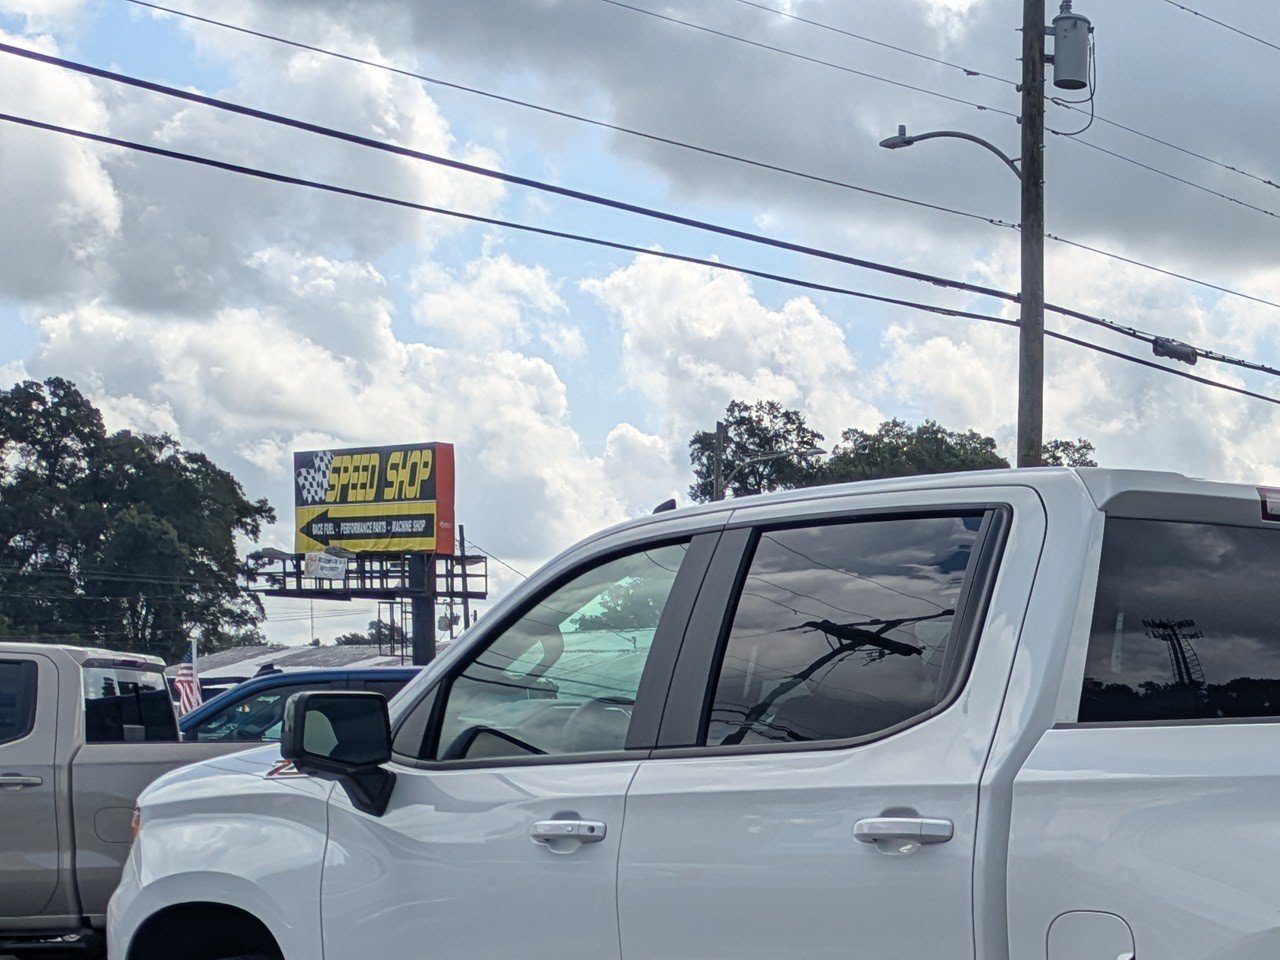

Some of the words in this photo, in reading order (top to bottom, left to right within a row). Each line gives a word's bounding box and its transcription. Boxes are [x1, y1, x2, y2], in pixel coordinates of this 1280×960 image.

[325, 453, 380, 503] SPEED
[383, 449, 432, 500] SHOP
[312, 523, 324, 535] RACE
[324, 523, 335, 535] FUEL
[340, 521, 372, 534] PERFORMANCE
[372, 521, 387, 533] PARTS
[391, 520, 412, 532] MACHINE
[412, 520, 426, 532] SHOP
